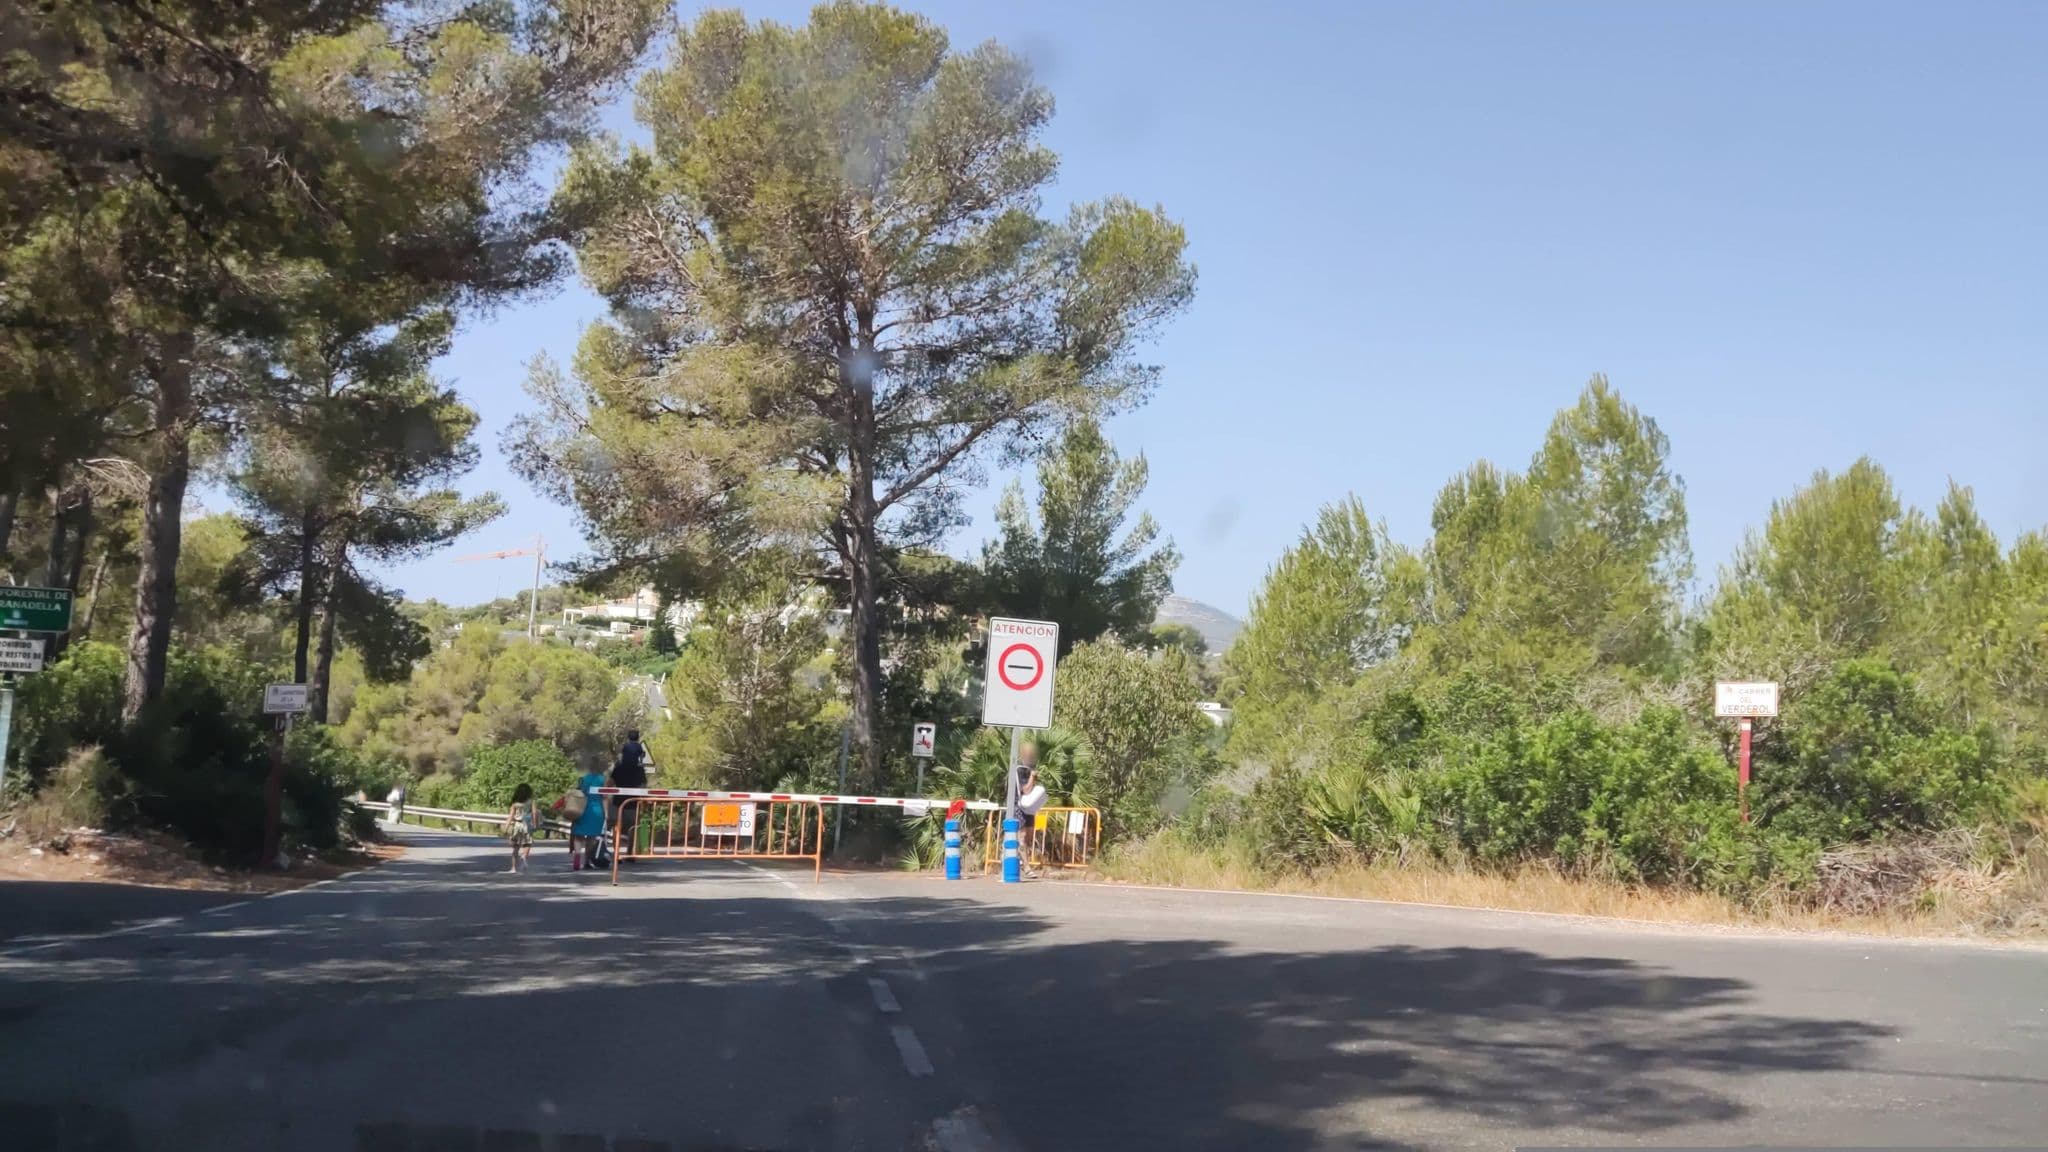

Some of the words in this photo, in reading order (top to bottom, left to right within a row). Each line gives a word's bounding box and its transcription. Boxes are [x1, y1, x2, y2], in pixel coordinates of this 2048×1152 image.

[54, 591, 68, 600] DE
[0, 640, 32, 649] OHIBIDO
[1721, 704, 1772, 714] VERDEROL
